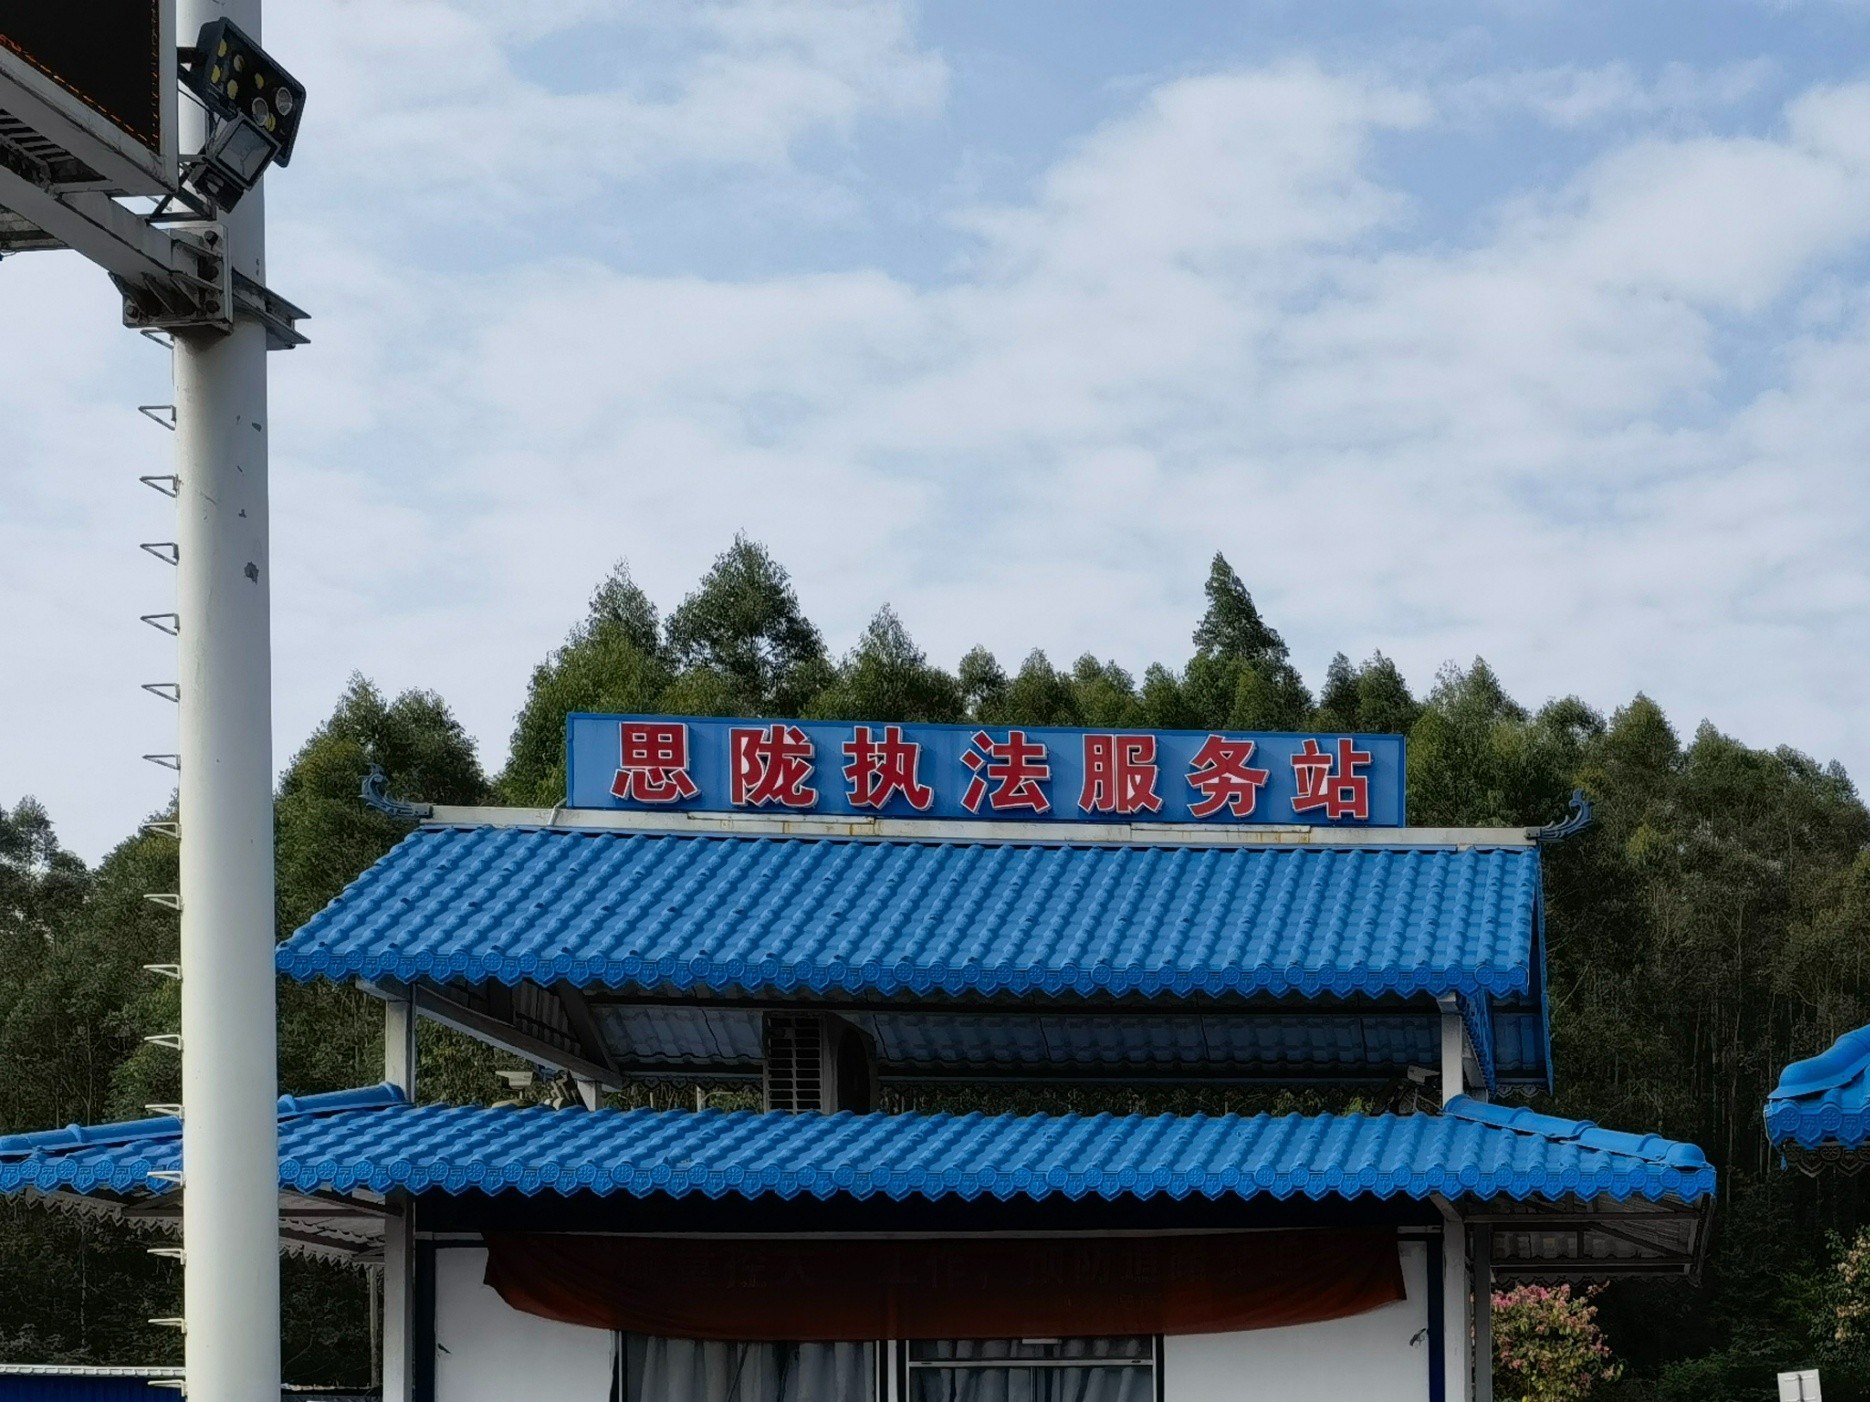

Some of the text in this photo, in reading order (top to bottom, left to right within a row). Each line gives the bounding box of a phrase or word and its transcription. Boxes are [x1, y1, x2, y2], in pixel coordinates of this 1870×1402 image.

[610, 721, 1374, 820] 思陇执法服务站
